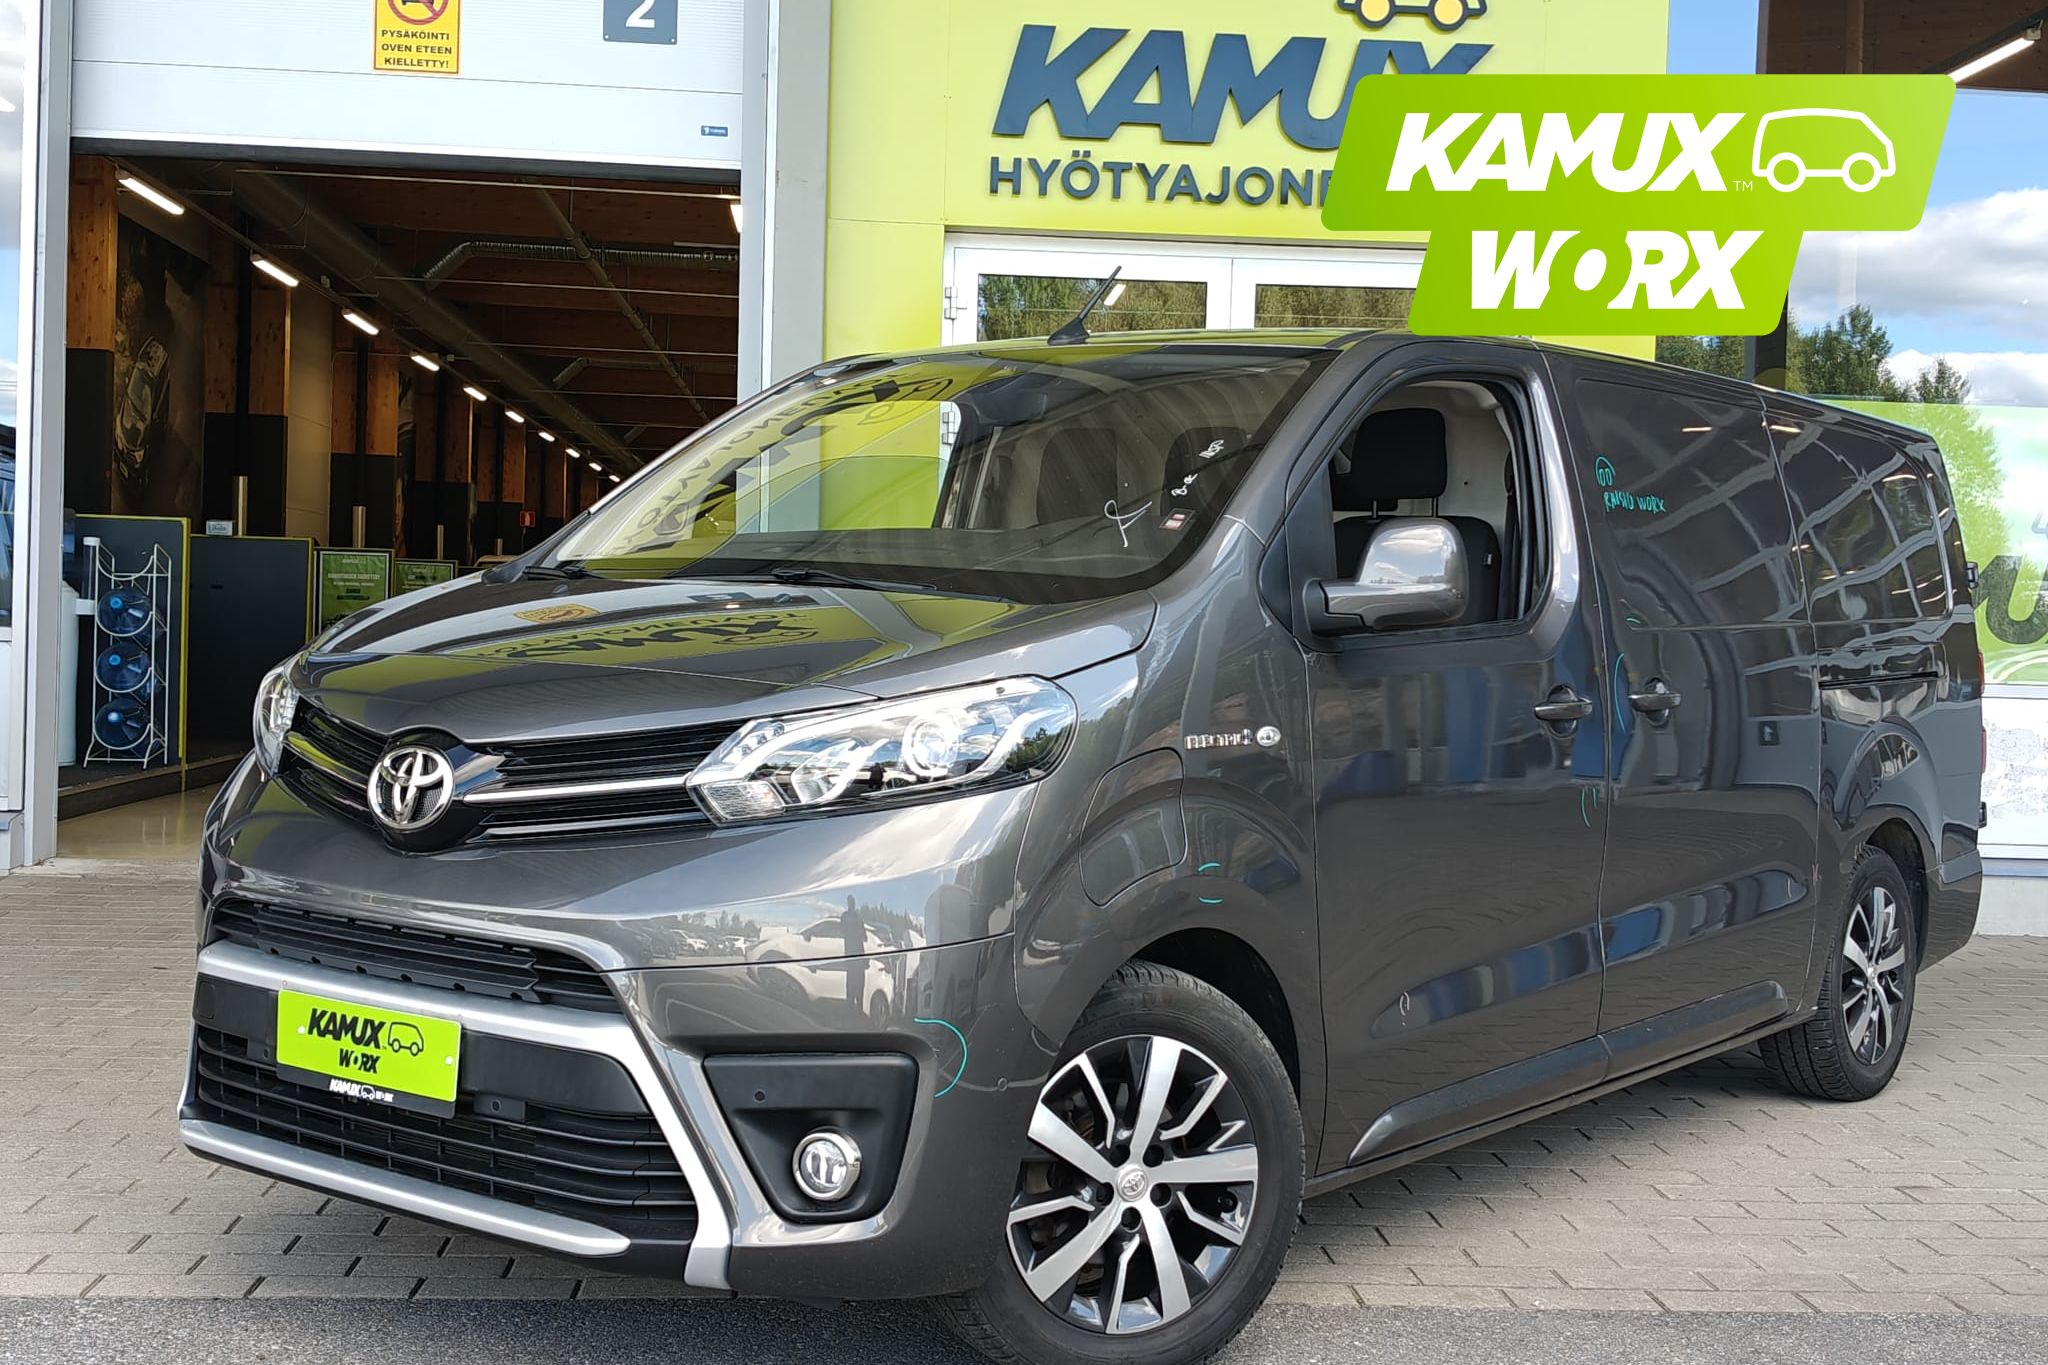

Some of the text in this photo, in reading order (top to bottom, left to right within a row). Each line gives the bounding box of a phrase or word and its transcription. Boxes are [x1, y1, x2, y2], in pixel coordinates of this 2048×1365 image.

[381, 28, 450, 41] PYSÄKÖINTI
[381, 43, 452, 55] OVEN ETEEN
[384, 57, 449, 69] KIELLETTY!
[307, 1007, 387, 1050] KAMUX
[338, 1047, 381, 1074] WORX
